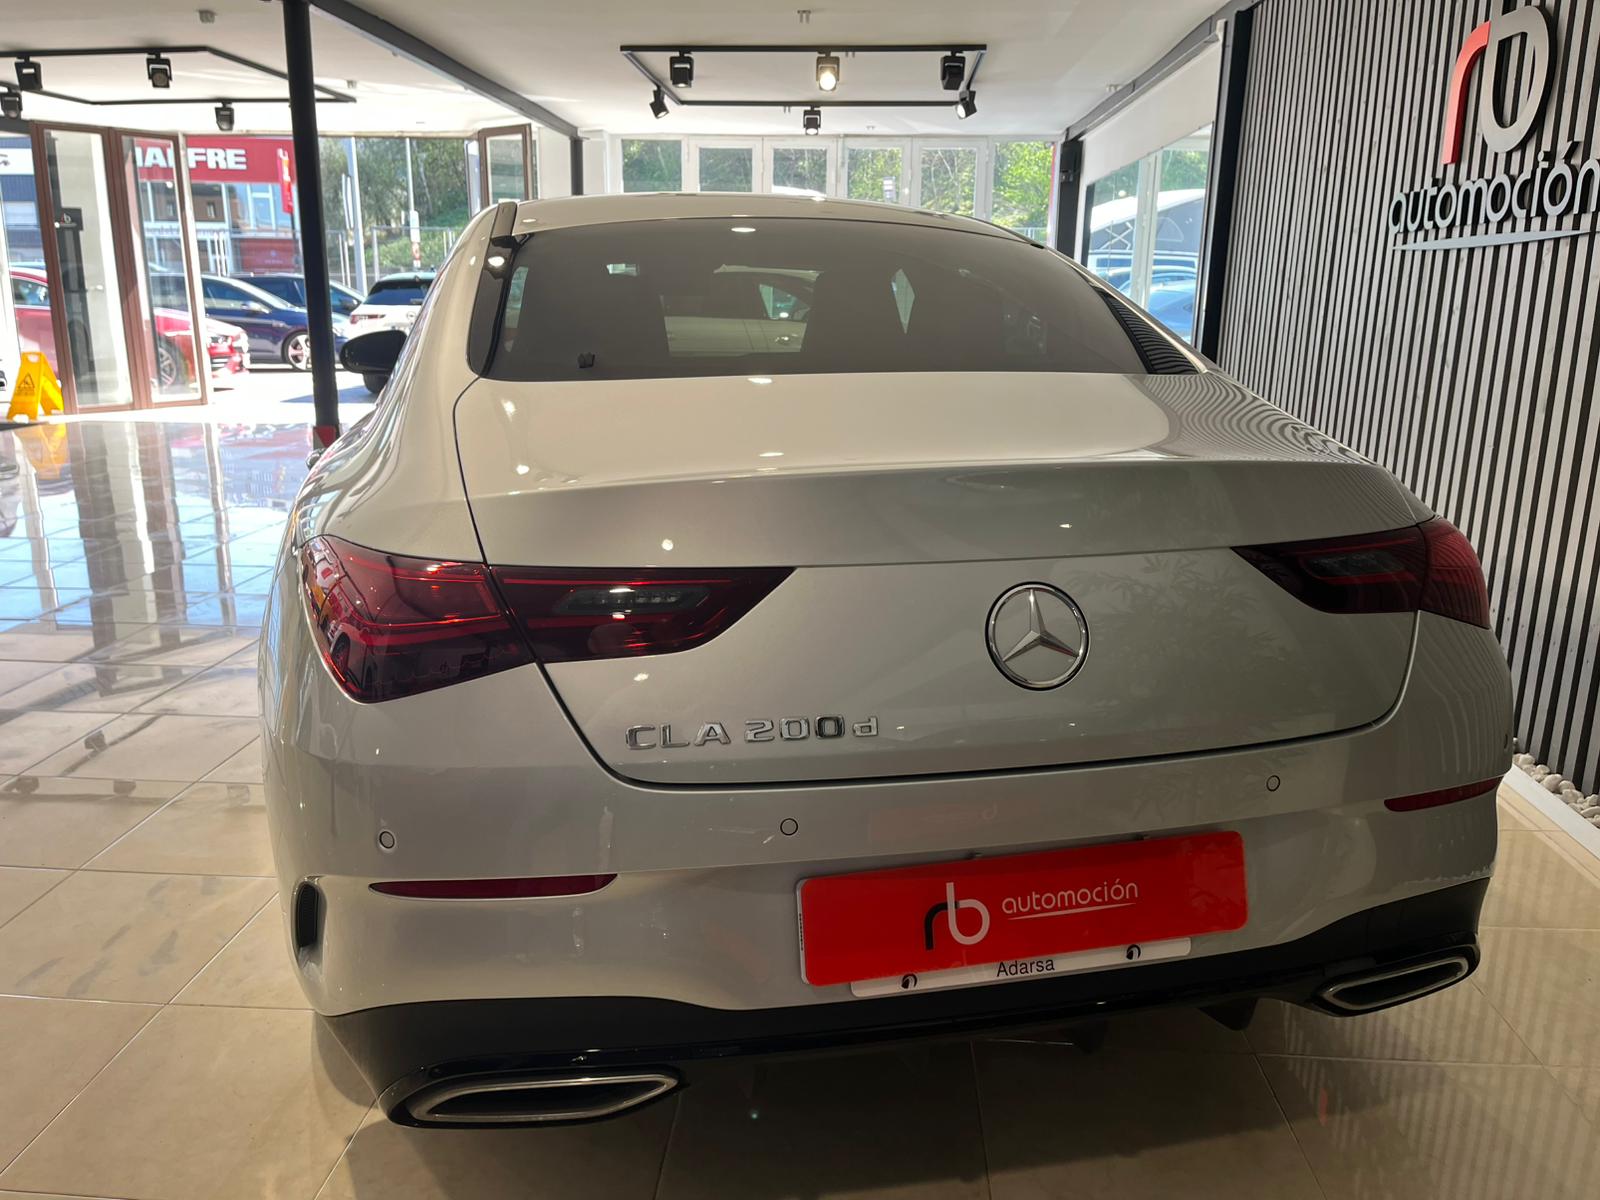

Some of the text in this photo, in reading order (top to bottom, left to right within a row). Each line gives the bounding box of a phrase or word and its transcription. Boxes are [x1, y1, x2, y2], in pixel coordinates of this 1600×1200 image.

[1388, 140, 1600, 234] automoción
[625, 721, 732, 750] CLA
[924, 878, 1139, 950] rb automoción
[996, 958, 1056, 978] Adarsa
